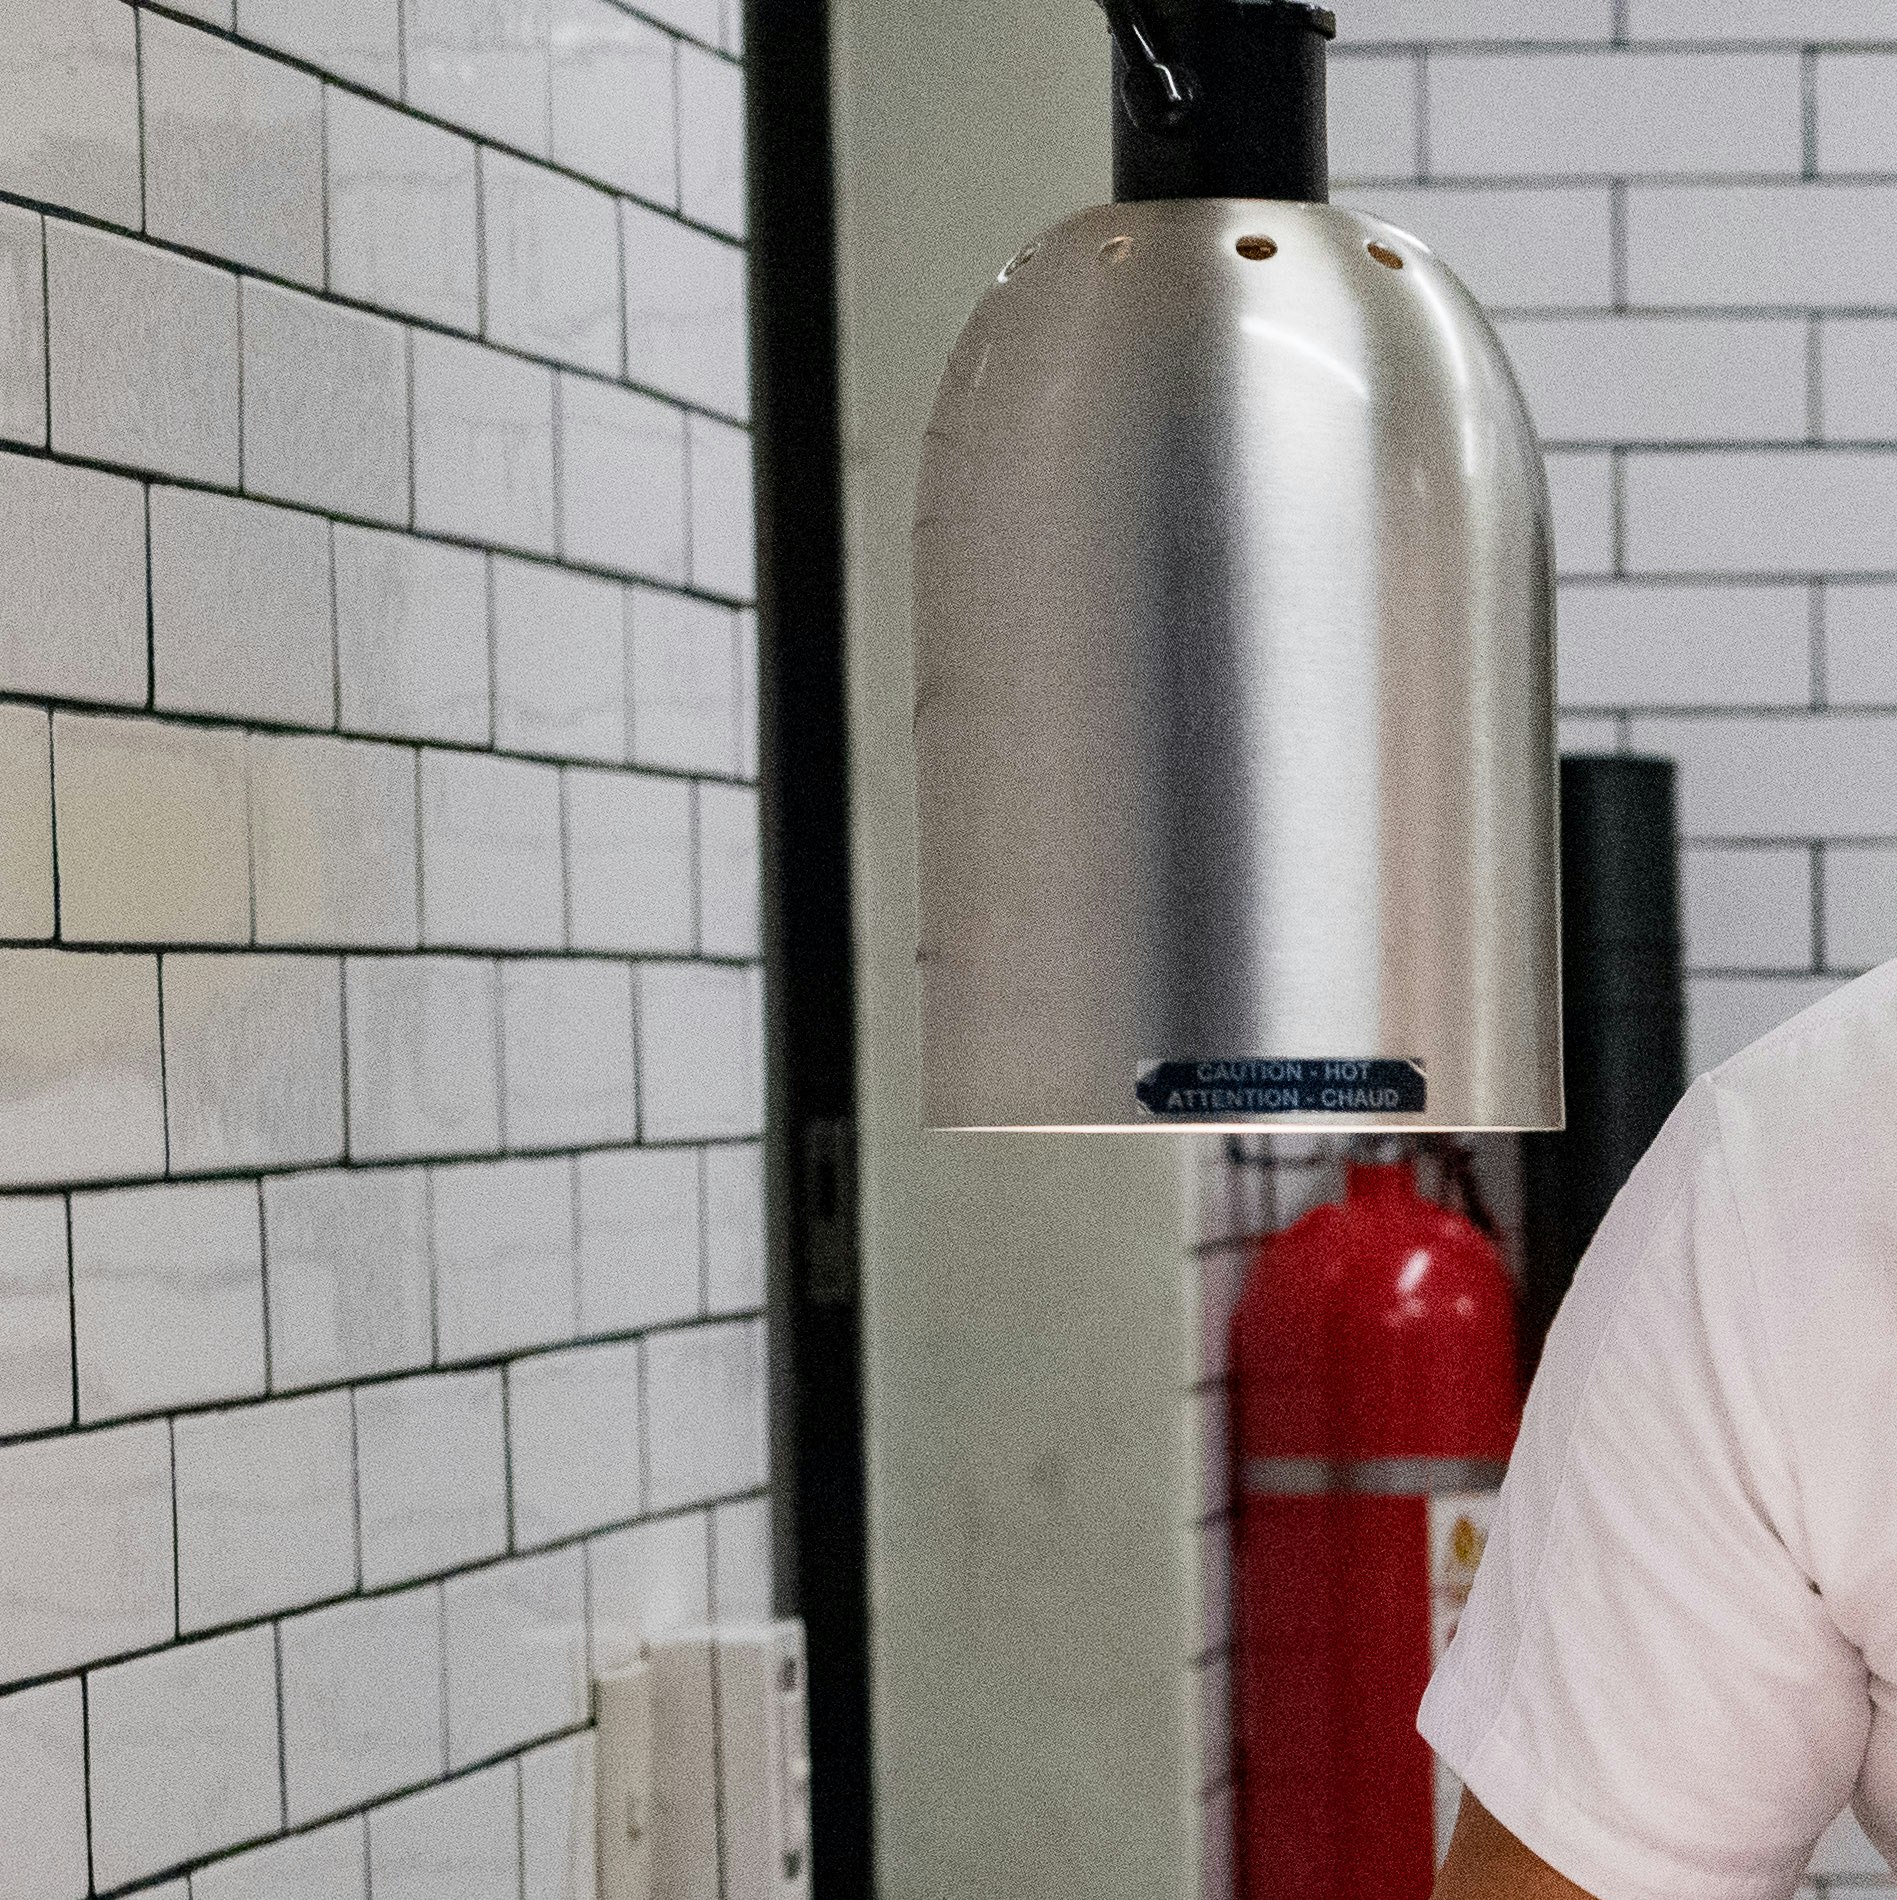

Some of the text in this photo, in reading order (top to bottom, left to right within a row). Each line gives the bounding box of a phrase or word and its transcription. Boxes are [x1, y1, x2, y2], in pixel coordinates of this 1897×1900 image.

[1197, 1061, 1303, 1081] CAUTION
[1324, 1061, 1370, 1081] HOT
[1166, 1087, 1299, 1109] ATTENTION
[1320, 1087, 1400, 1108] CHAUD
